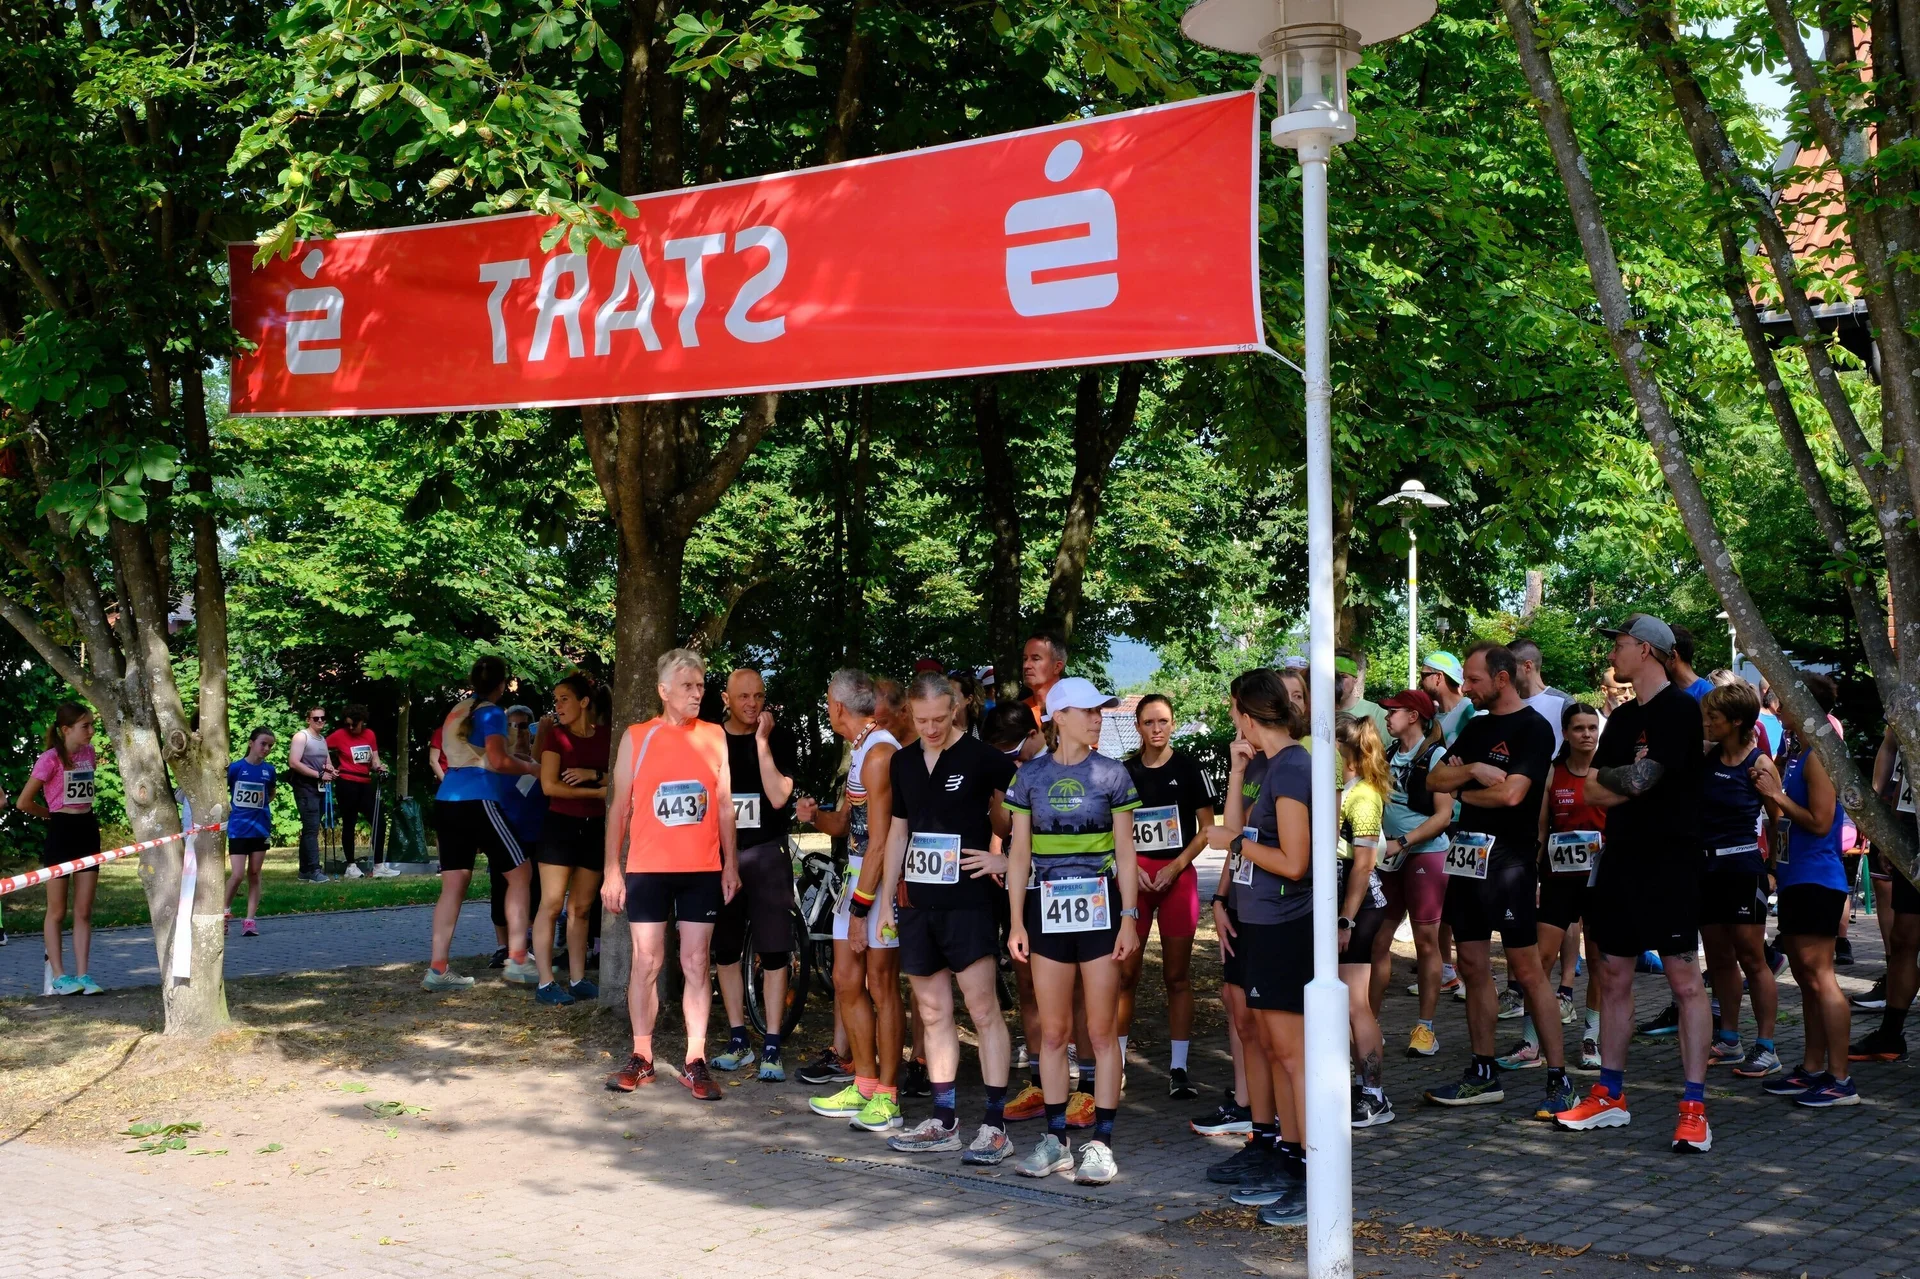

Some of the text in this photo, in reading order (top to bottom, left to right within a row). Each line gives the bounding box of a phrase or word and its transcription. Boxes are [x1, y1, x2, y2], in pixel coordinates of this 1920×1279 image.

[354, 751, 369, 761] 287
[67, 781, 94, 798] 526
[236, 790, 259, 804] 520
[657, 796, 697, 819] 443
[733, 800, 754, 821] 71
[1132, 821, 1164, 844] 461
[906, 850, 942, 875] 430
[1446, 845, 1477, 870] 434
[1553, 844, 1588, 866] 415
[1046, 897, 1090, 924] 418
